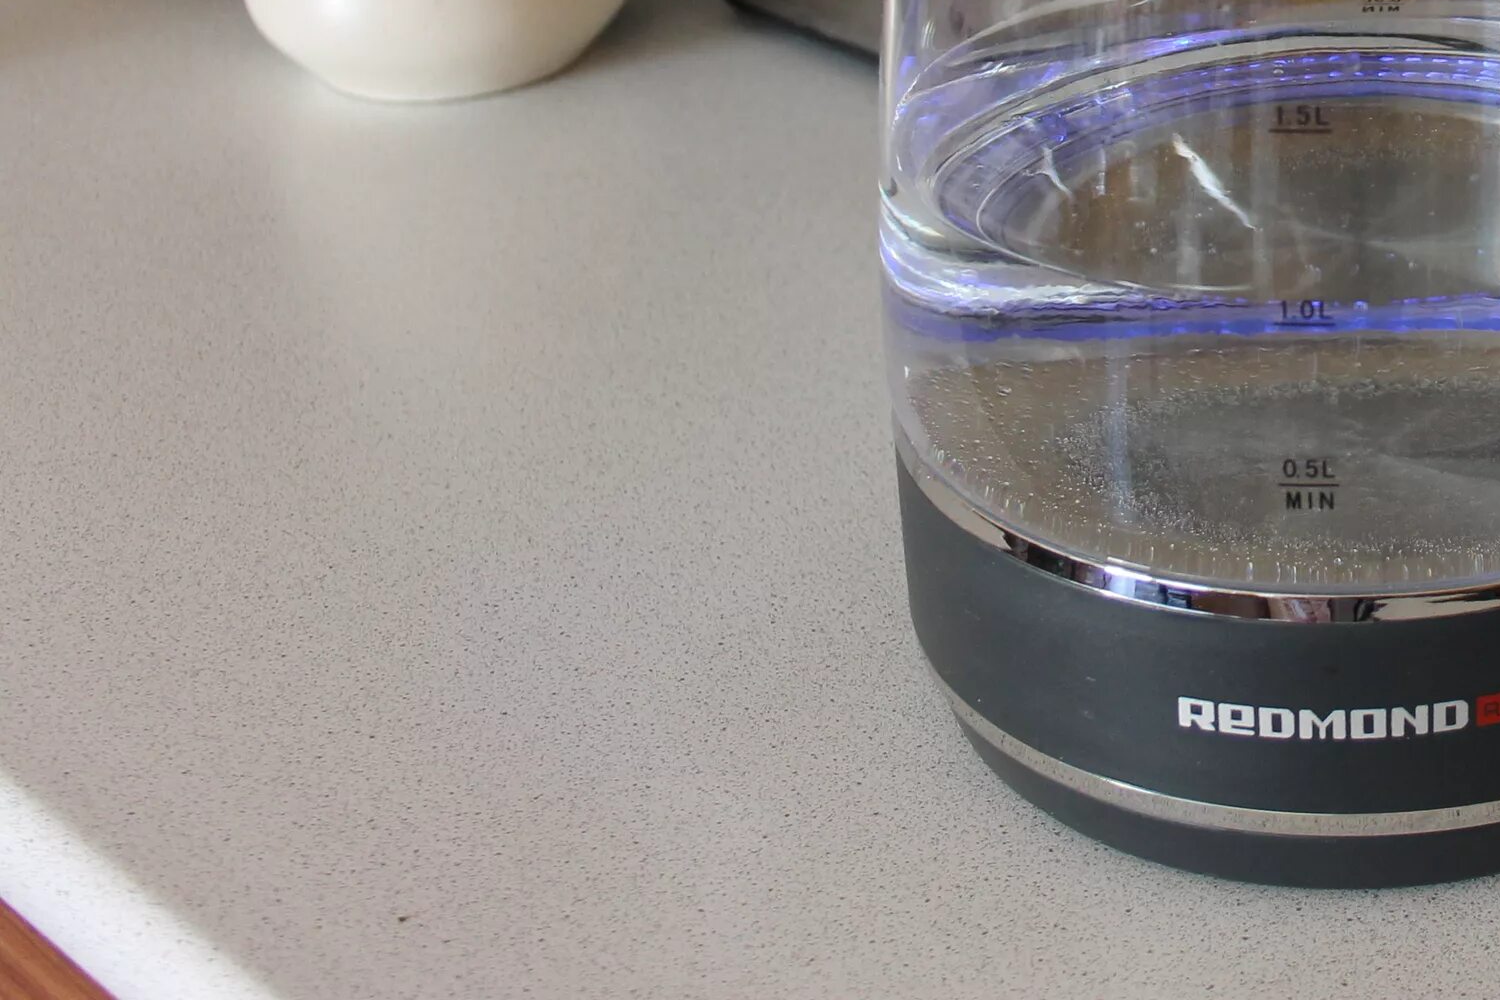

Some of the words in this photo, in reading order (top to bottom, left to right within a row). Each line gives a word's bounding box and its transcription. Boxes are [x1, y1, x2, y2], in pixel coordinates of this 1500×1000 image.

[1275, 106, 1330, 126] 1.5L
[1280, 300, 1333, 319] 1.0L
[1282, 459, 1335, 479] 0.5L
[1285, 491, 1334, 510] MIN
[1178, 696, 1469, 740] REDMOND
